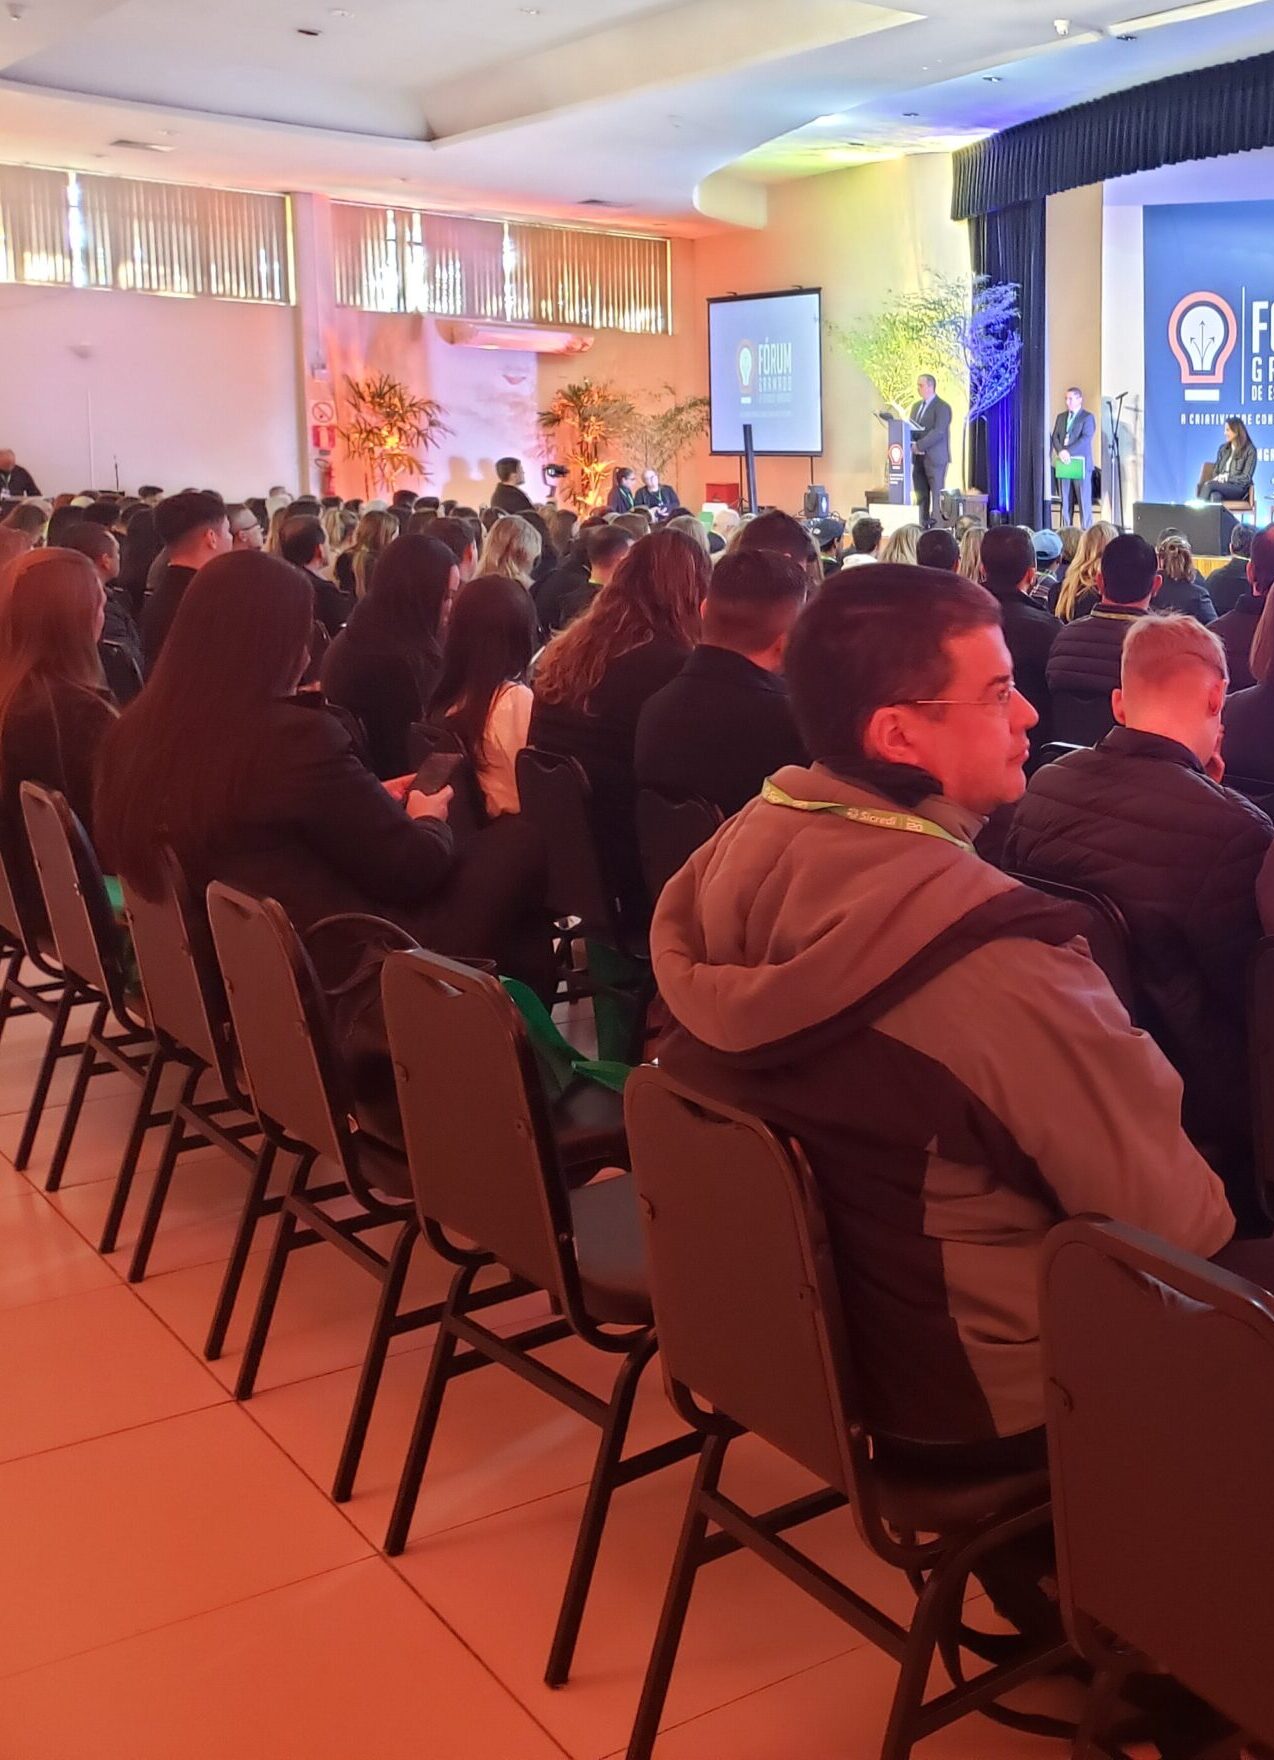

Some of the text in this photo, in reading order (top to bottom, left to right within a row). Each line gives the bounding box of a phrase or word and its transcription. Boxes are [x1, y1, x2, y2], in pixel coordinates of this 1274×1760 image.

[758, 336, 792, 375] FÓRUM
[1251, 384, 1263, 401] DE
[1180, 413, 1187, 425] A
